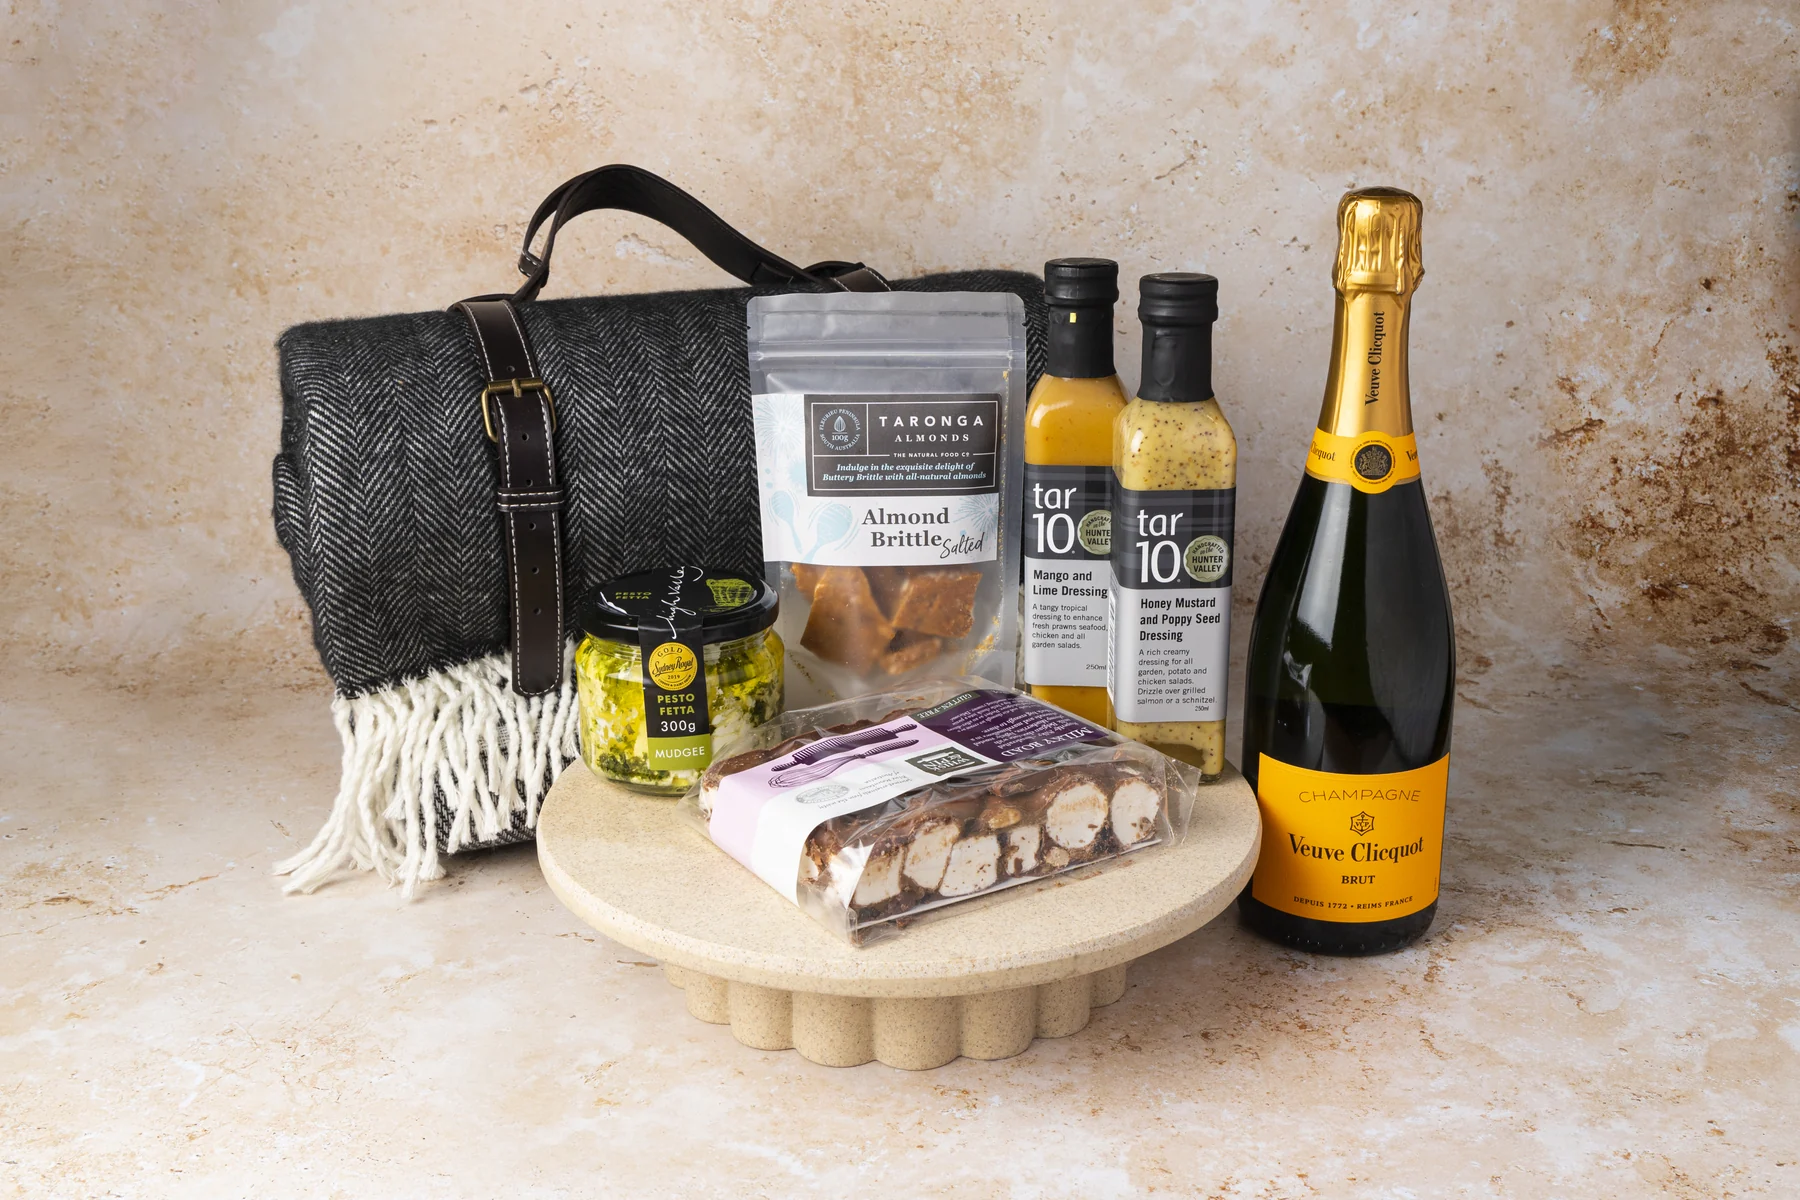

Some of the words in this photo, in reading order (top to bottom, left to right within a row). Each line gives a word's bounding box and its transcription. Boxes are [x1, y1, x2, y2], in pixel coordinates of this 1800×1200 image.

[1367, 311, 1386, 365] Clicquot
[1364, 368, 1381, 406] Veuve
[838, 409, 860, 430] PENINSULA
[879, 416, 984, 427] TARONGA
[820, 434, 834, 450] SOUTH
[834, 434, 860, 450] AUSTRALIA
[832, 434, 848, 442] 100g
[894, 434, 969, 442] ALMONDS
[836, 464, 869, 472] Indulge
[896, 463, 932, 472] exquisite
[935, 462, 964, 472] delight
[966, 462, 976, 472] of
[823, 474, 854, 482] Buttery
[906, 472, 952, 480] all-natural
[953, 472, 987, 480] almonds
[1032, 482, 1077, 510] tar
[862, 507, 950, 525] Almond
[1086, 516, 1112, 527] HANDCRAF
[1136, 509, 1184, 536] tar
[870, 530, 942, 547] Brittle
[940, 532, 985, 559] Salted
[1192, 542, 1224, 554] HANDCRAFTED
[1192, 556, 1224, 564] HUNTER
[1194, 564, 1222, 572] VALLEY
[1034, 570, 1069, 582] Mango
[1072, 572, 1092, 581] and
[1033, 585, 1058, 596] Lime
[1062, 586, 1108, 599] Dressing
[1040, 604, 1058, 612] tangy
[1140, 599, 1172, 610] Honey
[1176, 597, 1216, 608] Mustard
[1032, 613, 1062, 622] dressing
[1140, 614, 1158, 625] and
[1162, 614, 1192, 626] Poppy
[1196, 613, 1220, 624] Seed
[1140, 630, 1183, 642] Dressing
[658, 646, 682, 657] GOLD
[1163, 649, 1190, 658] creamy
[652, 660, 676, 677] Sydney
[676, 656, 694, 670] Royal
[1138, 668, 1166, 677] garden,
[1182, 687, 1206, 695] grilled
[657, 693, 695, 704] PESTO
[660, 706, 695, 716] FETTA
[917, 693, 972, 719] GLUTEN-FREE
[661, 720, 696, 732] 300g
[1042, 727, 1094, 744] MILKY
[655, 746, 705, 758] MUDGEE
[1001, 742, 1043, 756] ROAD
[1298, 789, 1422, 803] CHAMPAGNE
[1288, 832, 1345, 862] Veuve
[1350, 836, 1424, 864] Clicquot
[1341, 875, 1376, 885] BRUT
[1293, 896, 1324, 908] DEPUIS
[1385, 896, 1413, 908] FRANCE
